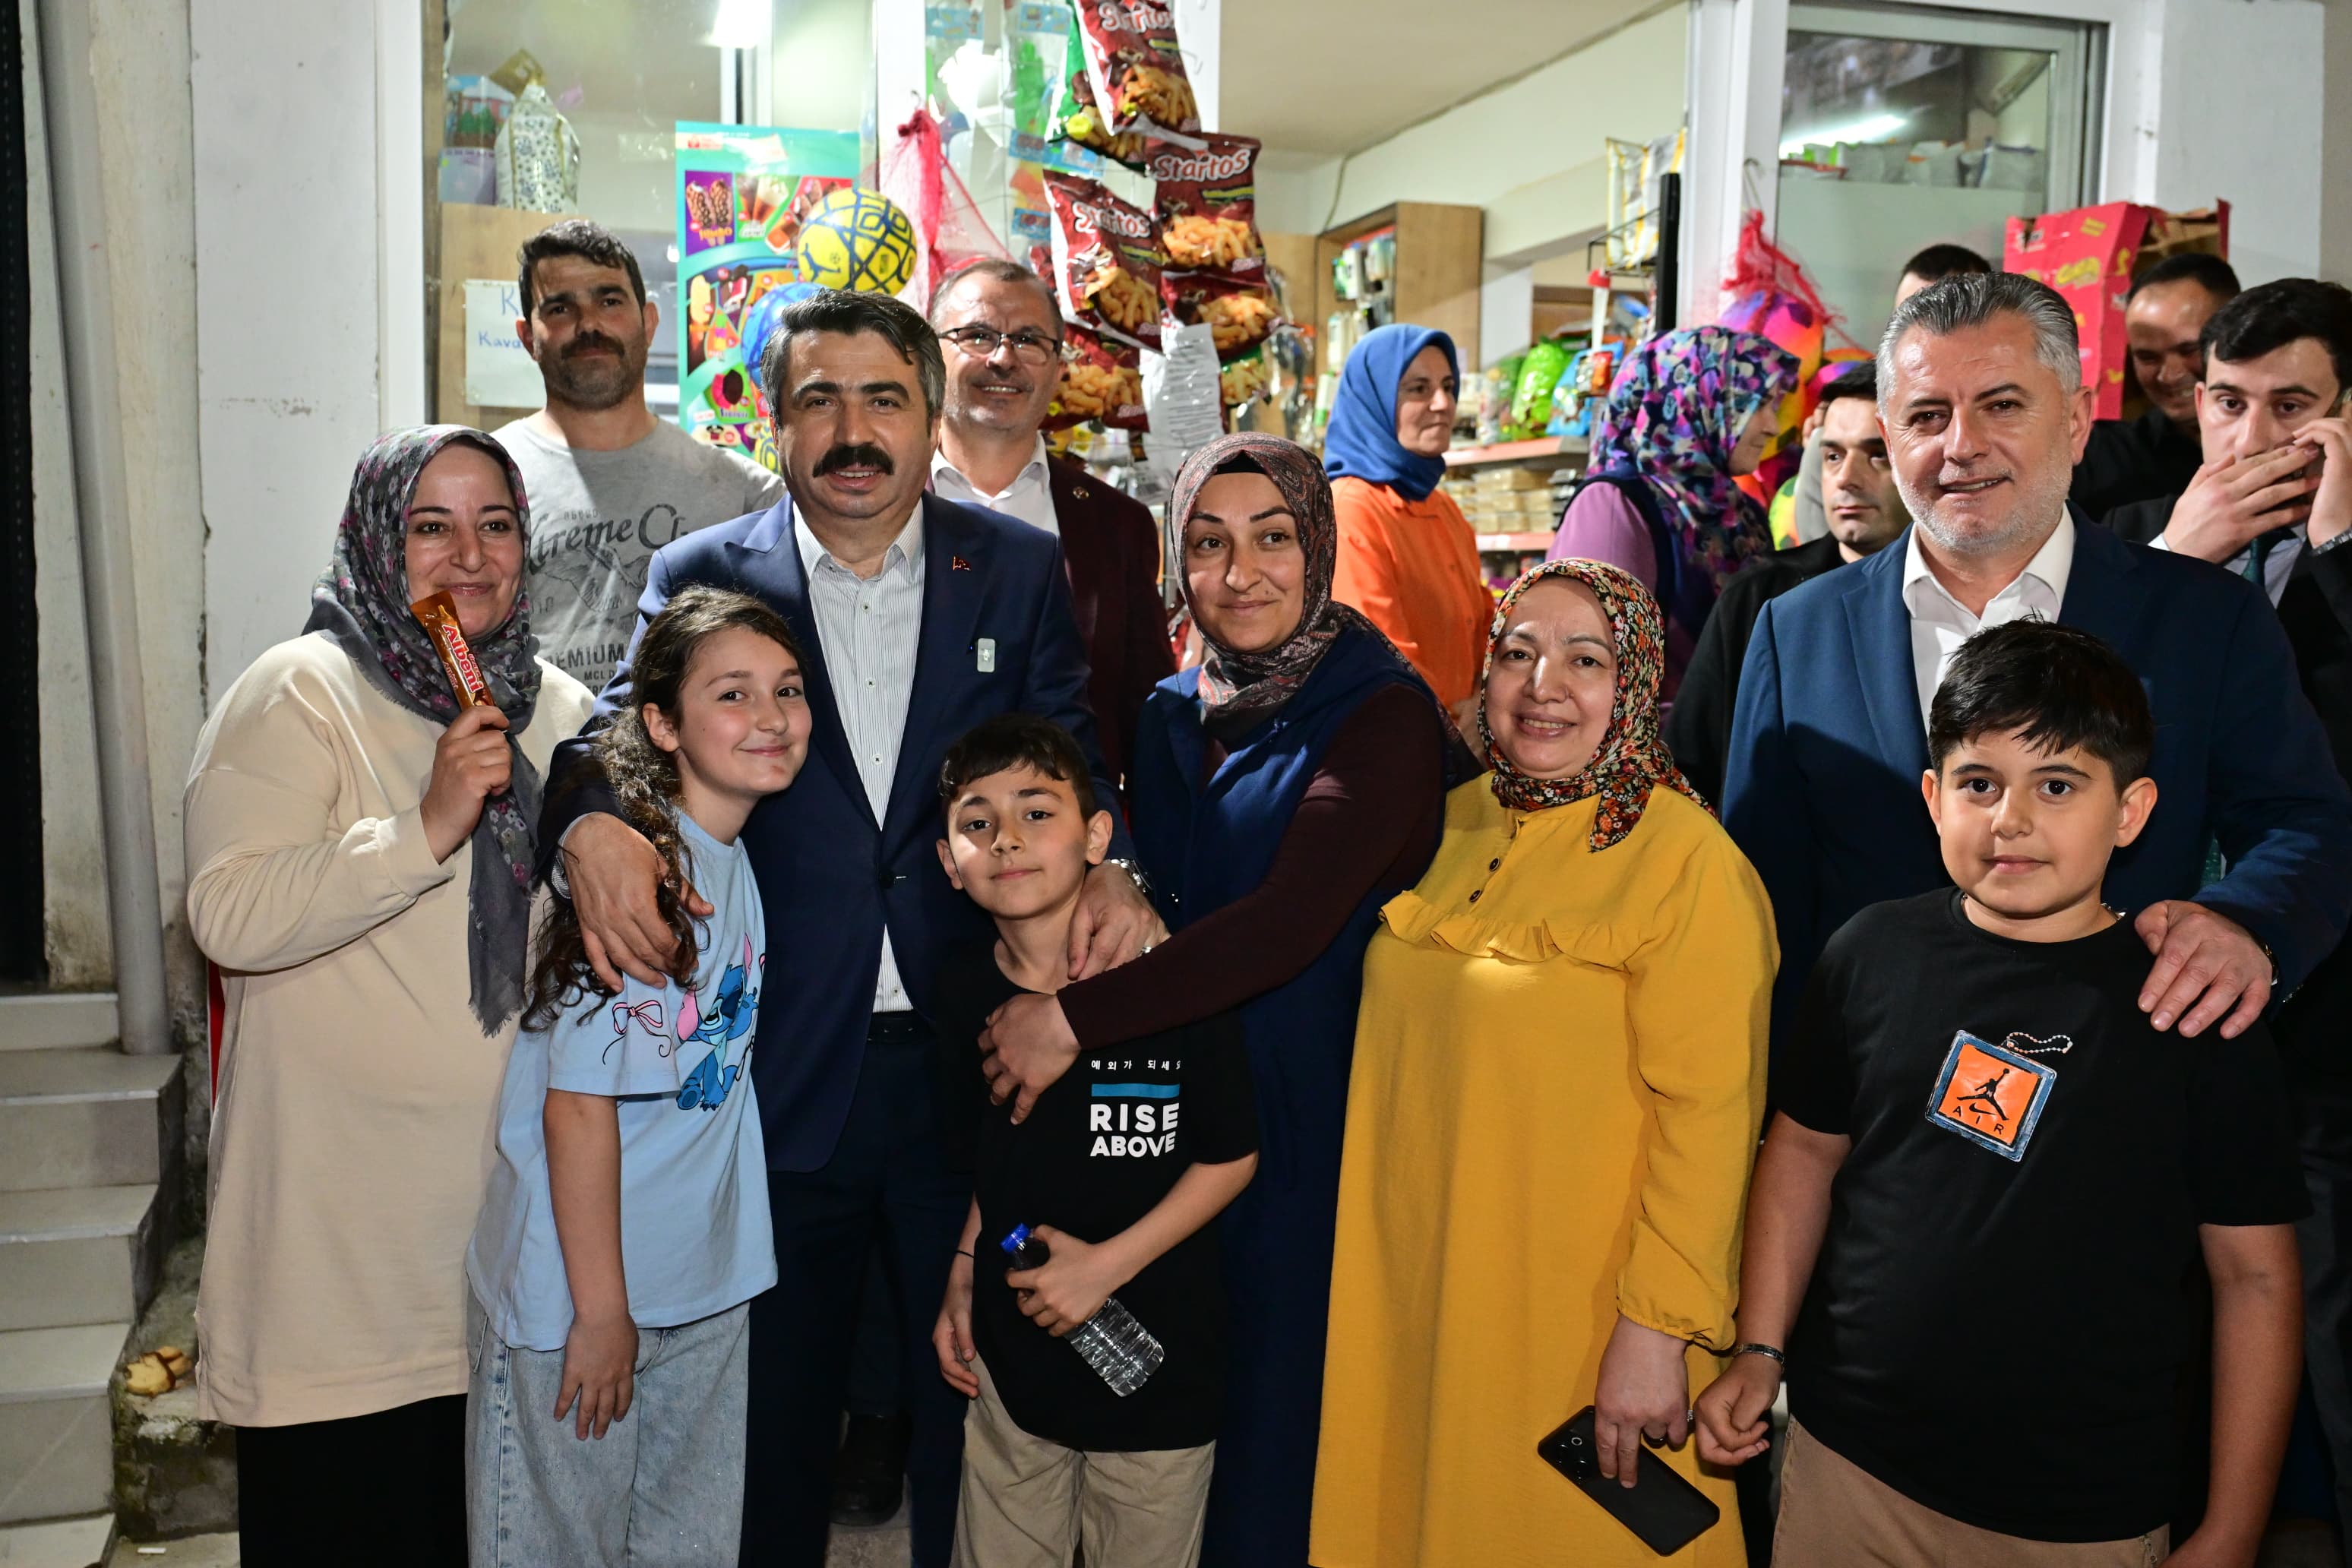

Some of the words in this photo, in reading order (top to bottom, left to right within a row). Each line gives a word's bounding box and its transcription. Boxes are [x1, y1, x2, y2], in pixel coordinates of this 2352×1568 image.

[1154, 148, 1251, 182] Startos
[501, 286, 519, 316] K
[478, 330, 522, 349] Kava
[441, 624, 485, 694] Albeni
[544, 643, 624, 669] EMIUM
[1090, 1103, 1180, 1133] RISE
[1953, 1105, 2004, 1135] AIR
[1089, 1131, 1176, 1158] ABOVE
